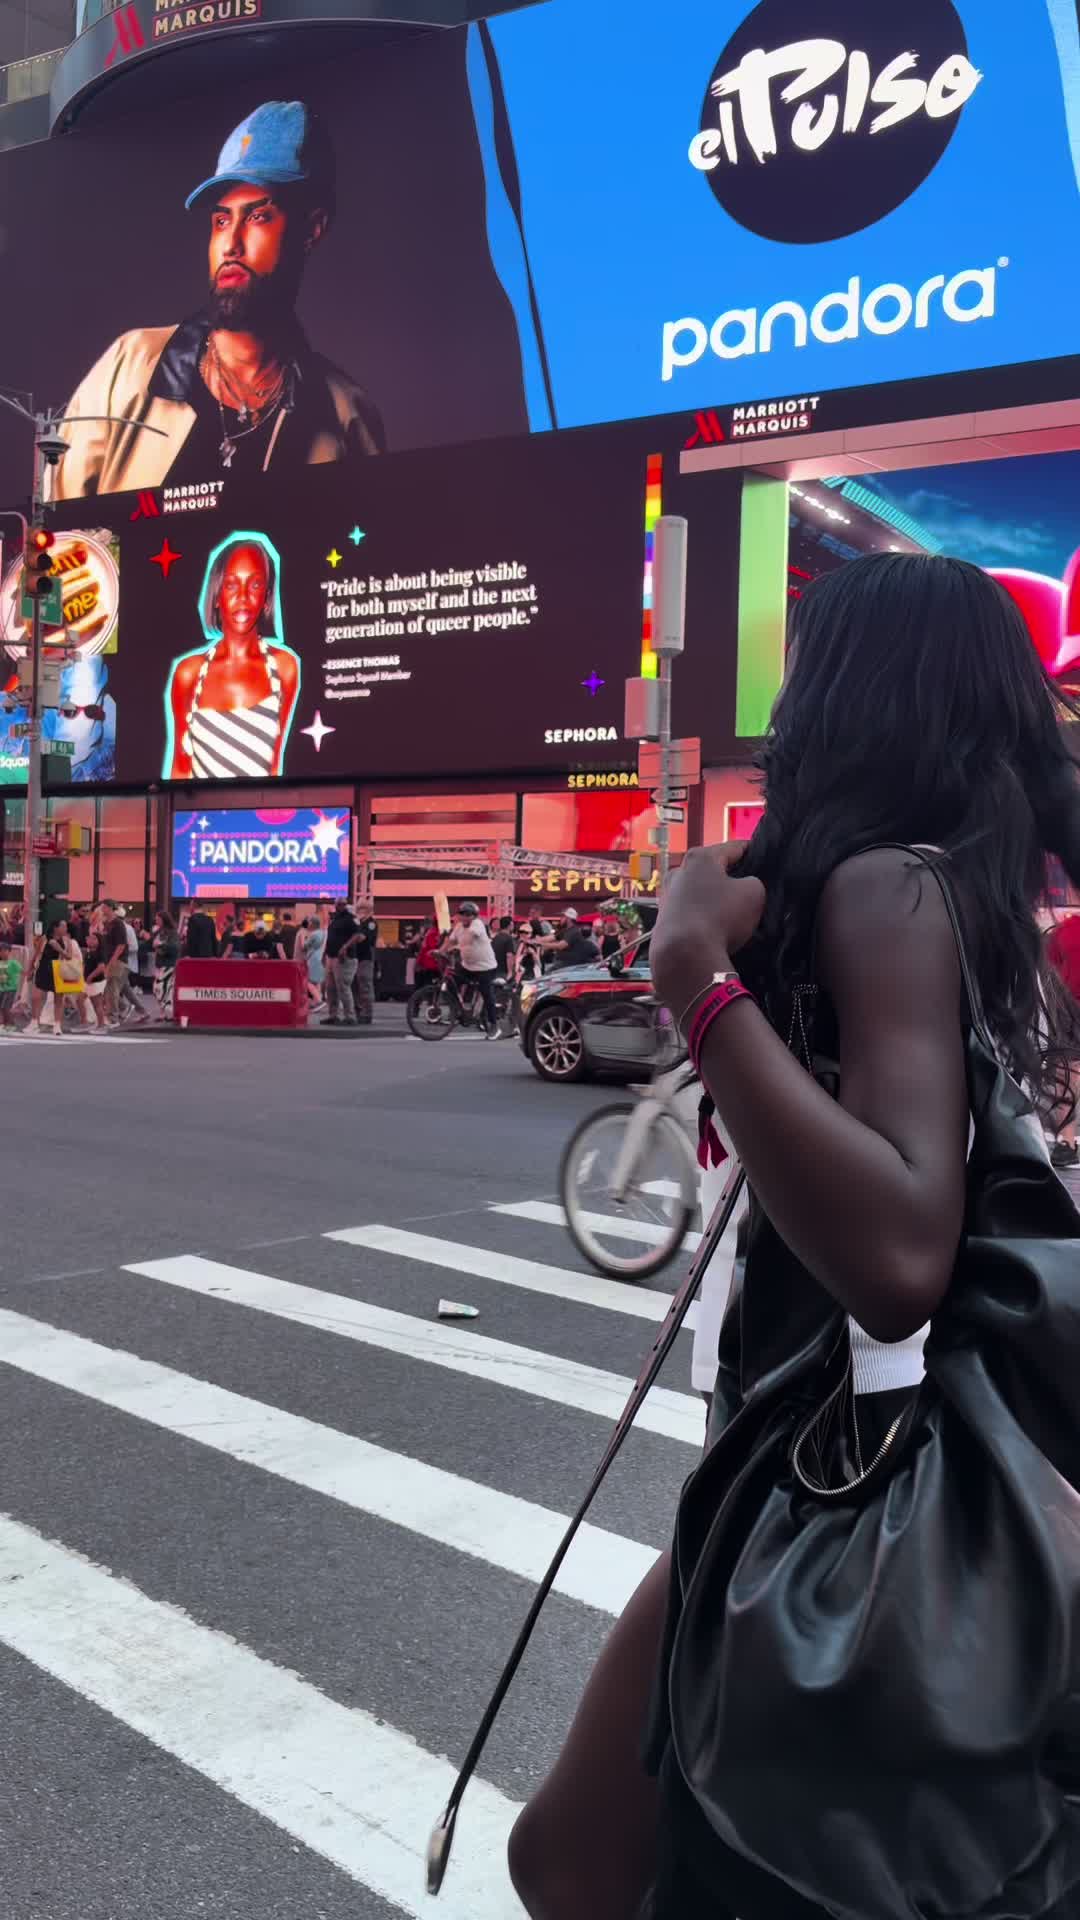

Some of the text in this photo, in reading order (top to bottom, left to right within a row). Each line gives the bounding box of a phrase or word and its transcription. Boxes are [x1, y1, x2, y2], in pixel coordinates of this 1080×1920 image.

[154, 0, 257, 36] MARQUIS
[661, 266, 996, 382] pandora
[733, 397, 820, 421] MARRIOTT
[732, 414, 809, 437] MARQUIS
[163, 481, 225, 499] MARRIOTT
[163, 495, 217, 513] MARQUIS
[369, 576, 382, 594] is
[385, 573, 429, 593] about
[430, 568, 474, 588] being
[475, 560, 527, 582] visible
[326, 584, 538, 619] for both myself and the next
[325, 619, 404, 644] generation
[407, 616, 425, 634] of
[426, 616, 471, 636] queer
[544, 726, 618, 743] SEPHORA
[568, 773, 639, 788] SEPHORA
[200, 839, 318, 864] PANDORA
[194, 989, 276, 1001] TIMES SQUARE
